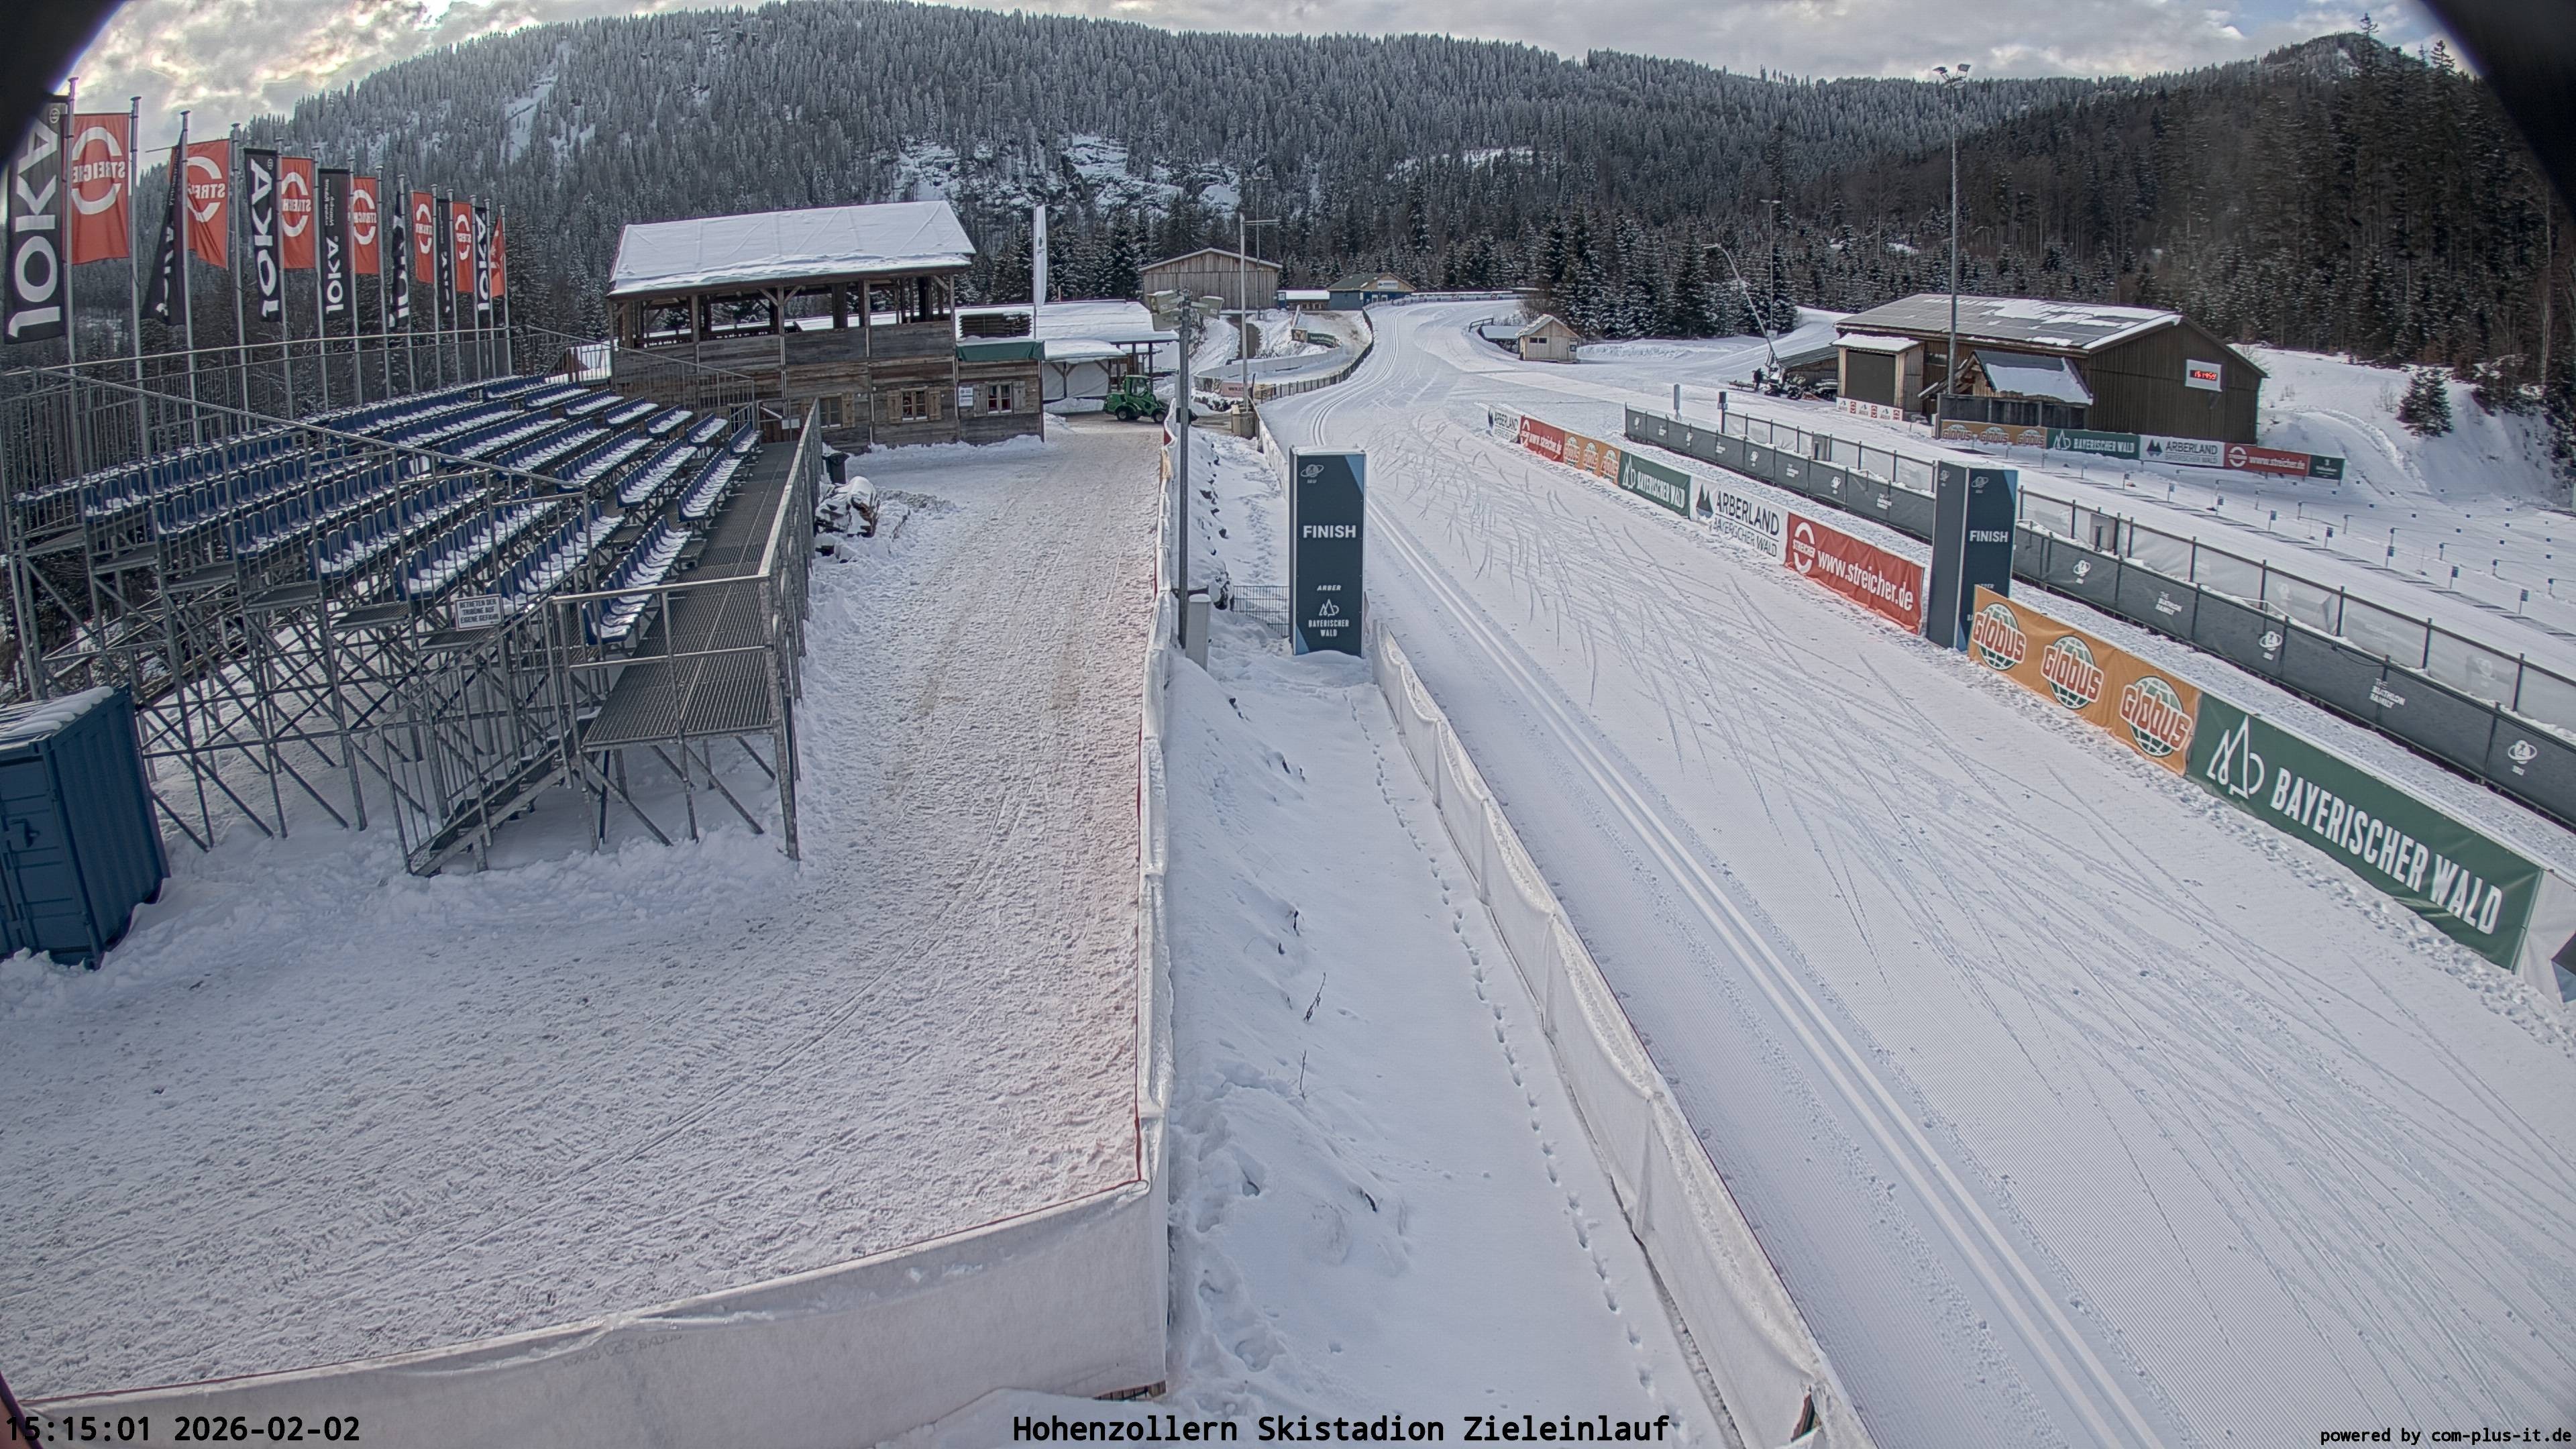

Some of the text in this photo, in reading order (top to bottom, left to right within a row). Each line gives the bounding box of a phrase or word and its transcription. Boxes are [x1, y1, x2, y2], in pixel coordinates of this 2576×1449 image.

[2074, 438, 2135, 453] BAYERISCHER WALD
[2166, 441, 2218, 455] ARBERLAND
[1716, 490, 1780, 536] ARBERLAND
[1303, 525, 1356, 538] FINISH
[1969, 530, 2008, 543] FINISH
[1756, 536, 1778, 557] WALD
[1817, 550, 1913, 611] www.streicher.de
[1308, 619, 1349, 628] BAYERISCHER
[2270, 767, 2503, 934] BAYERISCHER WALD
